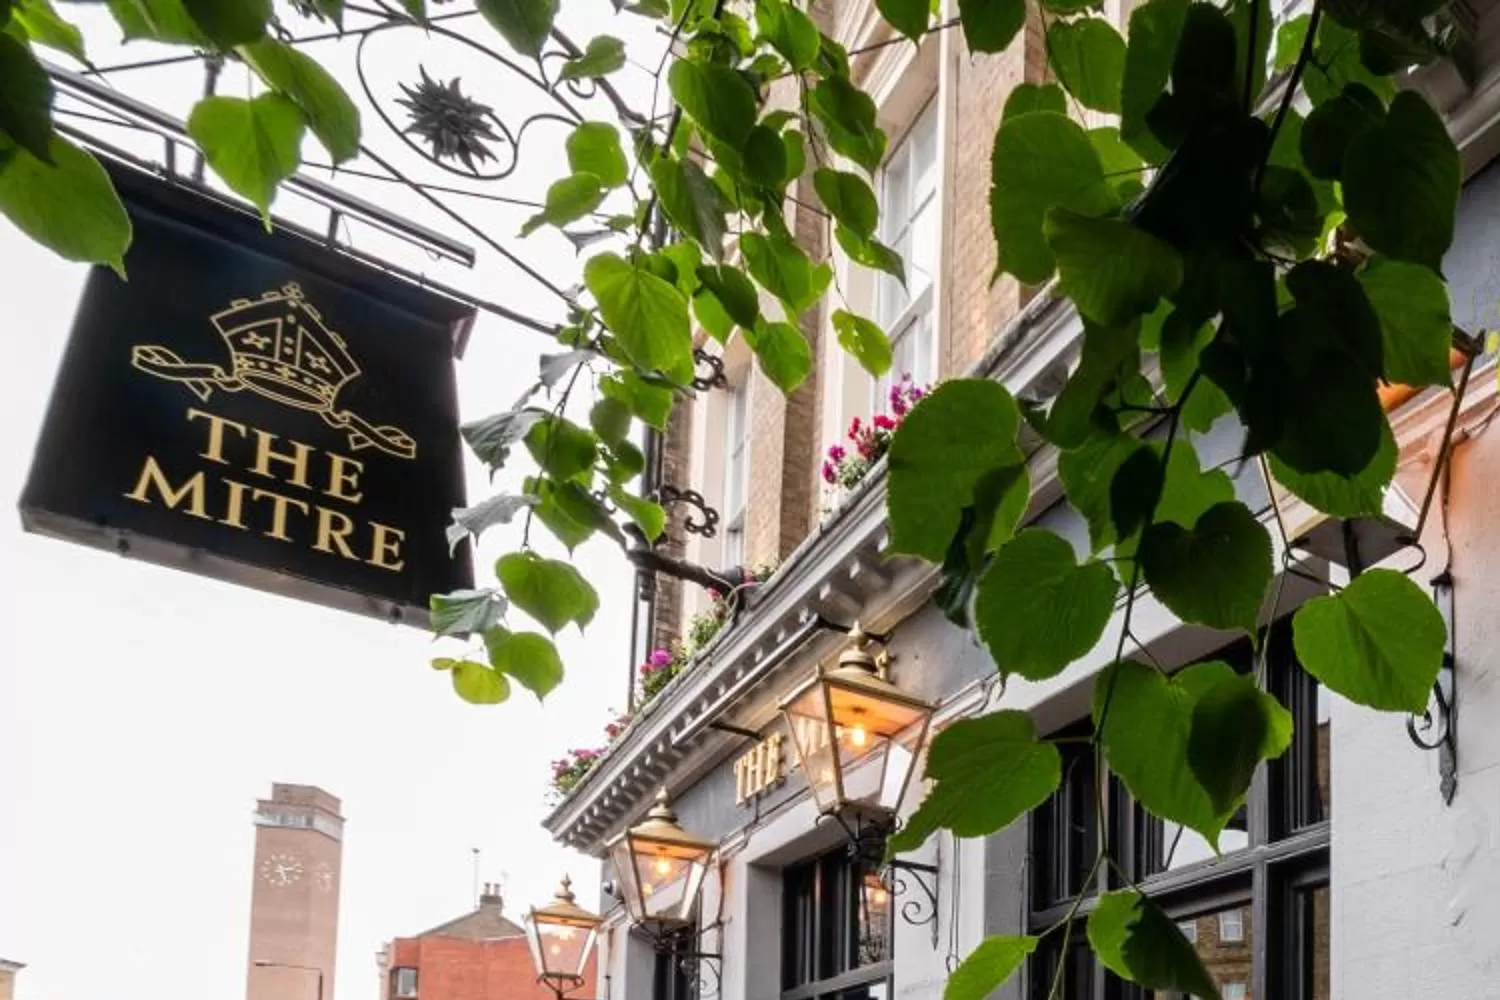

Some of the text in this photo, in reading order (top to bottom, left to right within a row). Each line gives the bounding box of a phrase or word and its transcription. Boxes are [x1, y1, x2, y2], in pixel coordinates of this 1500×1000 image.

[187, 408, 363, 504] THE
[125, 457, 405, 571] MITRE
[733, 731, 780, 806] THE
